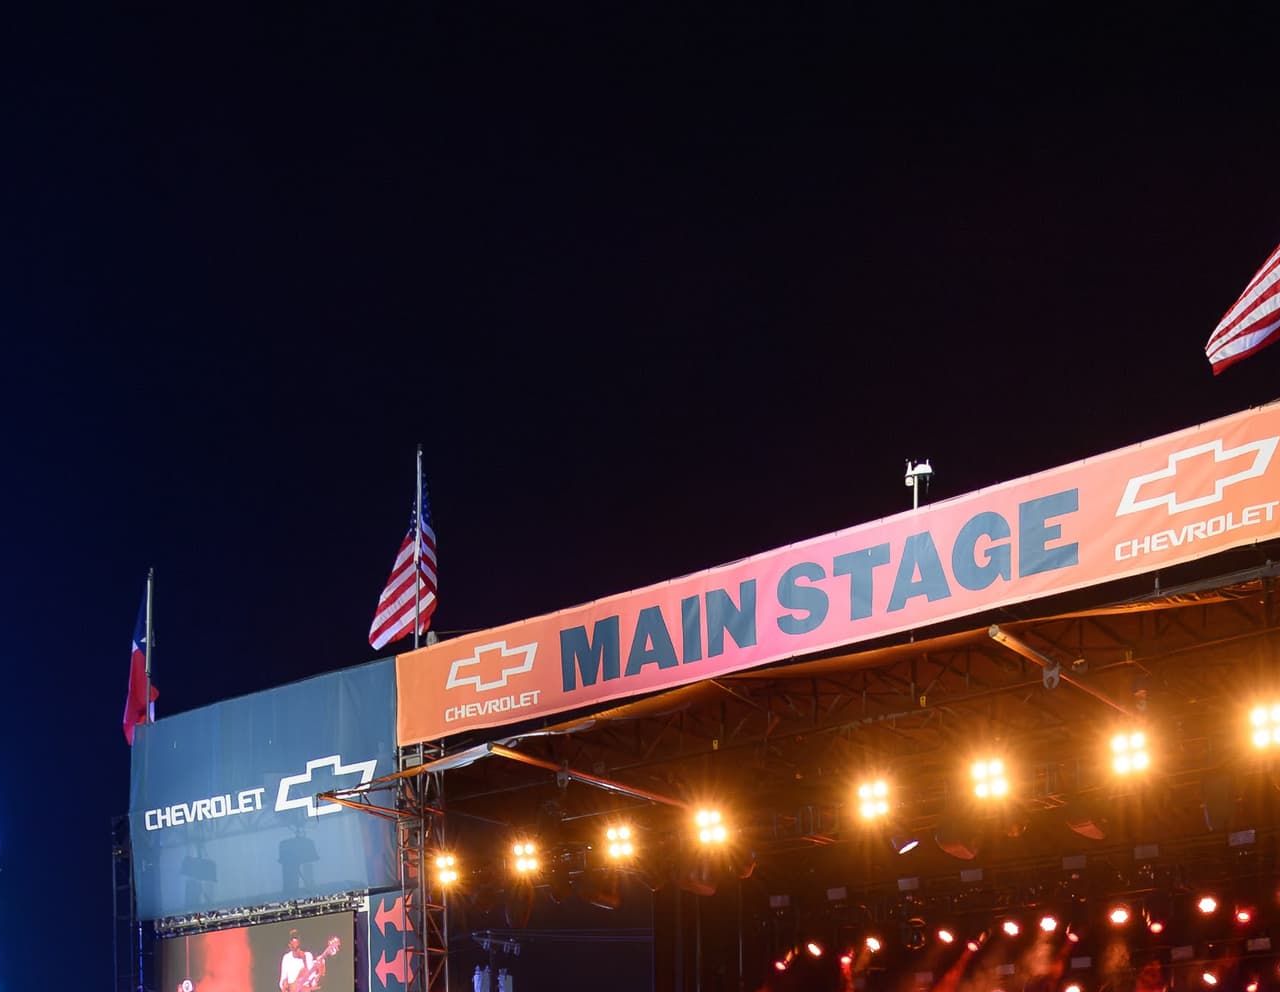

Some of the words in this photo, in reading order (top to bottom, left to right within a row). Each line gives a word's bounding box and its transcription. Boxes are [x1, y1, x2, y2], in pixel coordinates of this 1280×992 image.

[1114, 501, 1280, 561] CHEVROLET
[560, 578, 757, 692] MAIN
[776, 488, 1080, 635] STAGE
[445, 690, 541, 722] CHEVROLET
[145, 788, 265, 831] CHEVROLET
